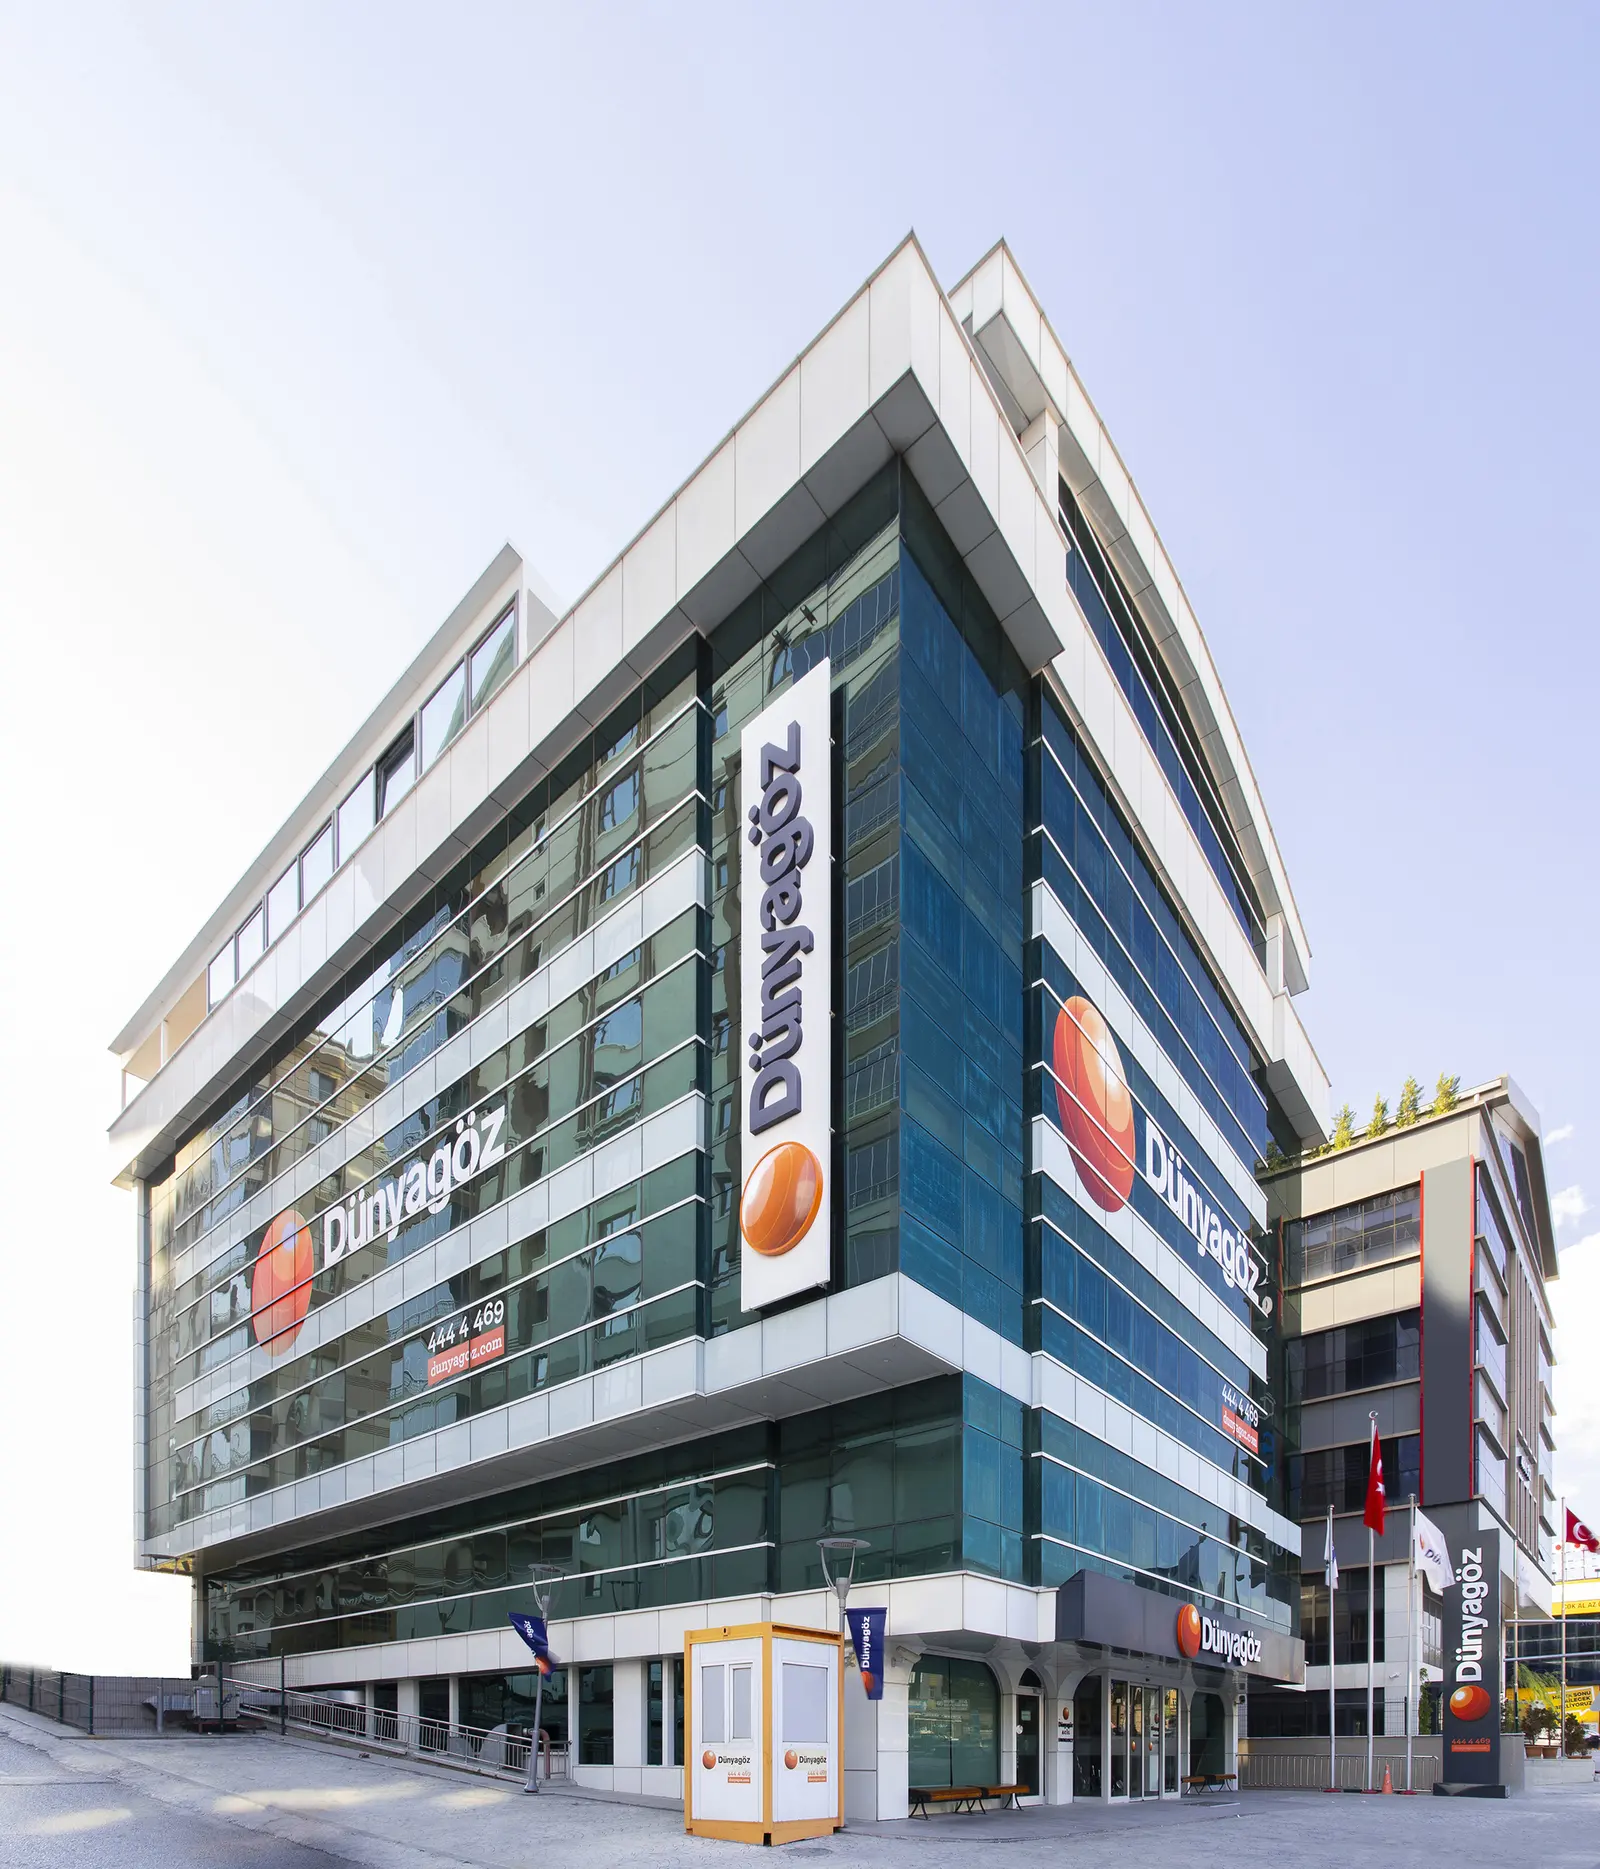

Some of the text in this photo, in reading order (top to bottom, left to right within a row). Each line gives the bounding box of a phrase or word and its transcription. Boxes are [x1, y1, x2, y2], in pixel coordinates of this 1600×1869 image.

[749, 721, 814, 1136] Dünyagöz
[323, 1105, 505, 1269] Dünyagöz
[1145, 1116, 1260, 1305] Dünyagöz
[427, 1300, 505, 1353] 444 4 469
[430, 1337, 503, 1377] dunyagoz.com
[1221, 1383, 1259, 1428] 444 4 469
[1455, 1547, 1489, 1683] Dünyagöz
[861, 1616, 871, 1668] Dünyagöz
[1202, 1616, 1261, 1667] Dünyagöz
[718, 1755, 751, 1766] Dünyagöz
[799, 1755, 827, 1765] Dünyagöz
[1475, 1737, 1491, 1745] 469
